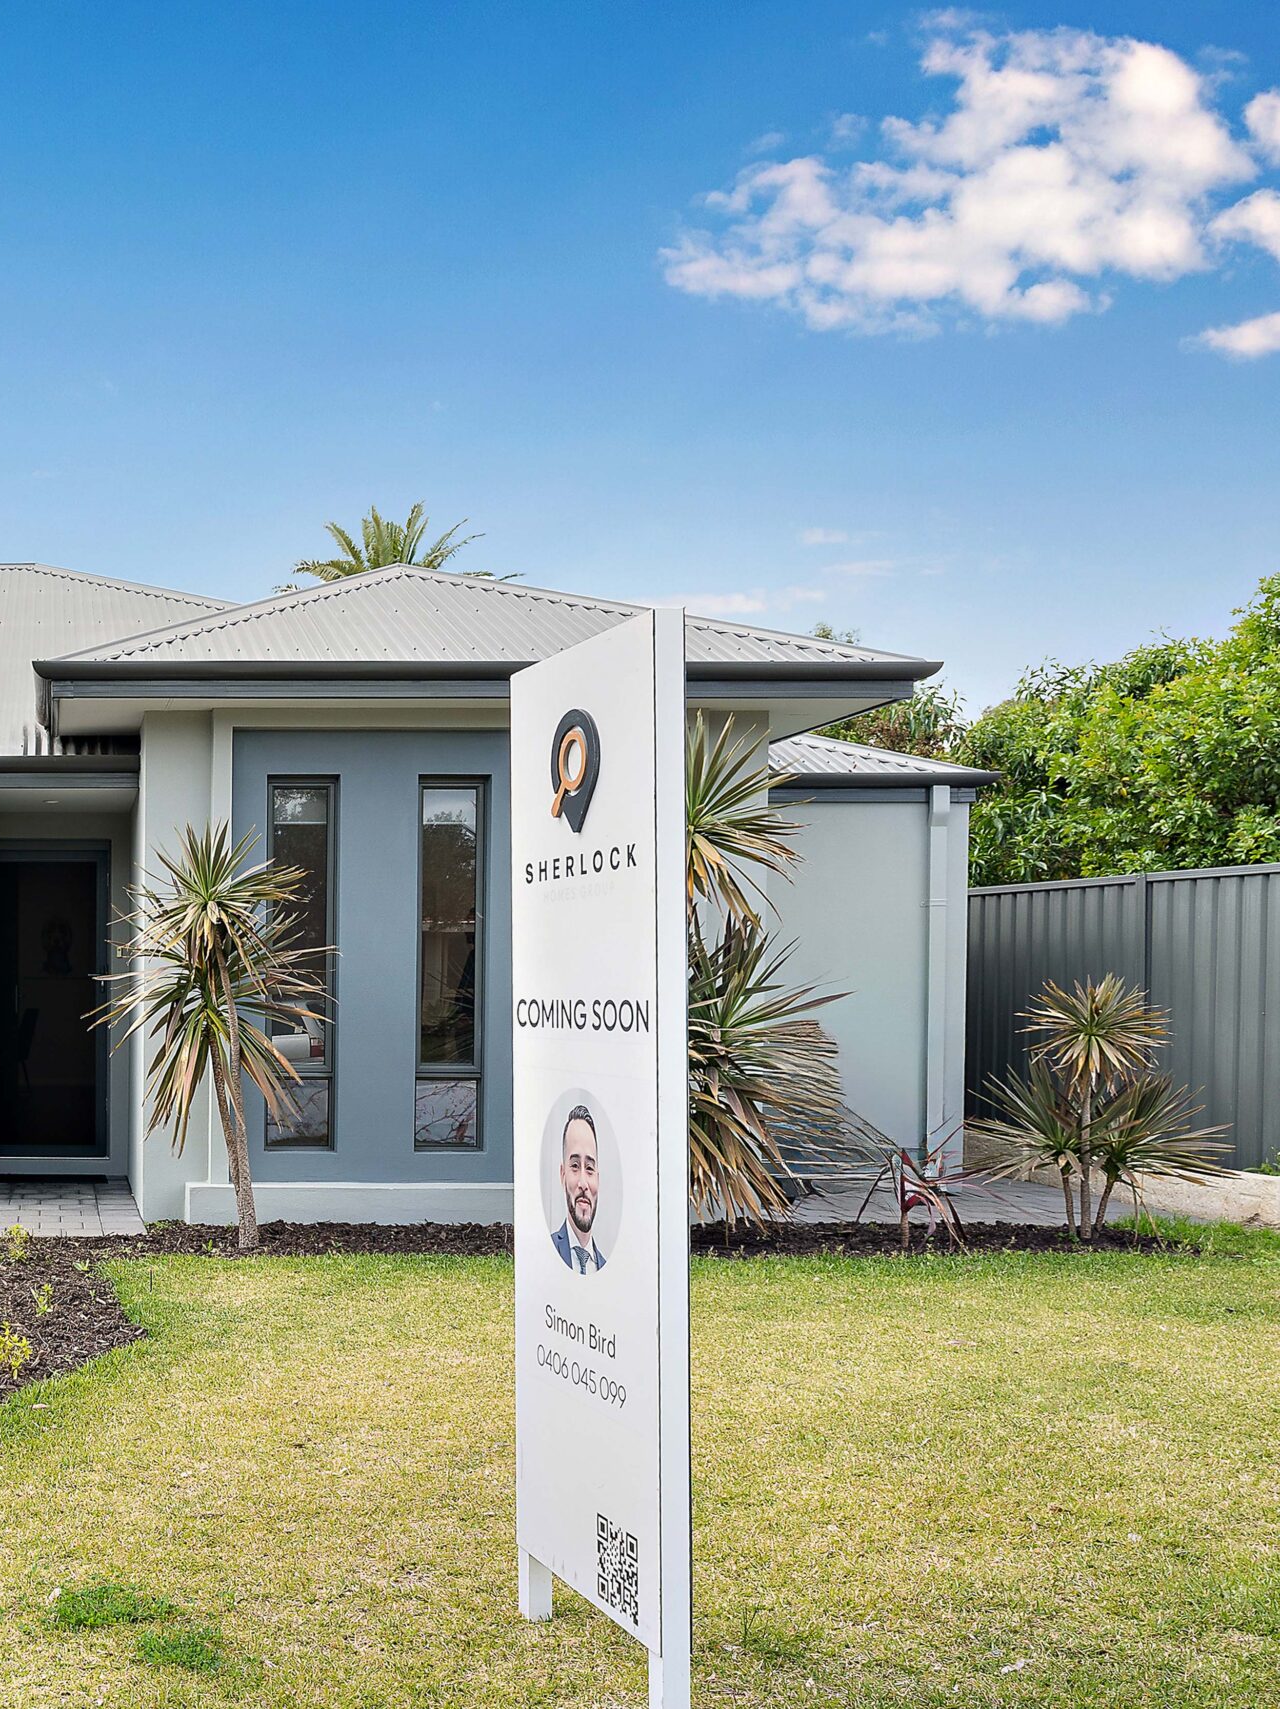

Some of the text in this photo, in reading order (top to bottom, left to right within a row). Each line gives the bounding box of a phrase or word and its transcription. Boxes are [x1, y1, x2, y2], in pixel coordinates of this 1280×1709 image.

[525, 843, 637, 884] SHERLOCK
[517, 998, 649, 1032] COMING SOON
[545, 1304, 616, 1359] Simon Bird
[536, 1344, 627, 1409] 0406 045 099
